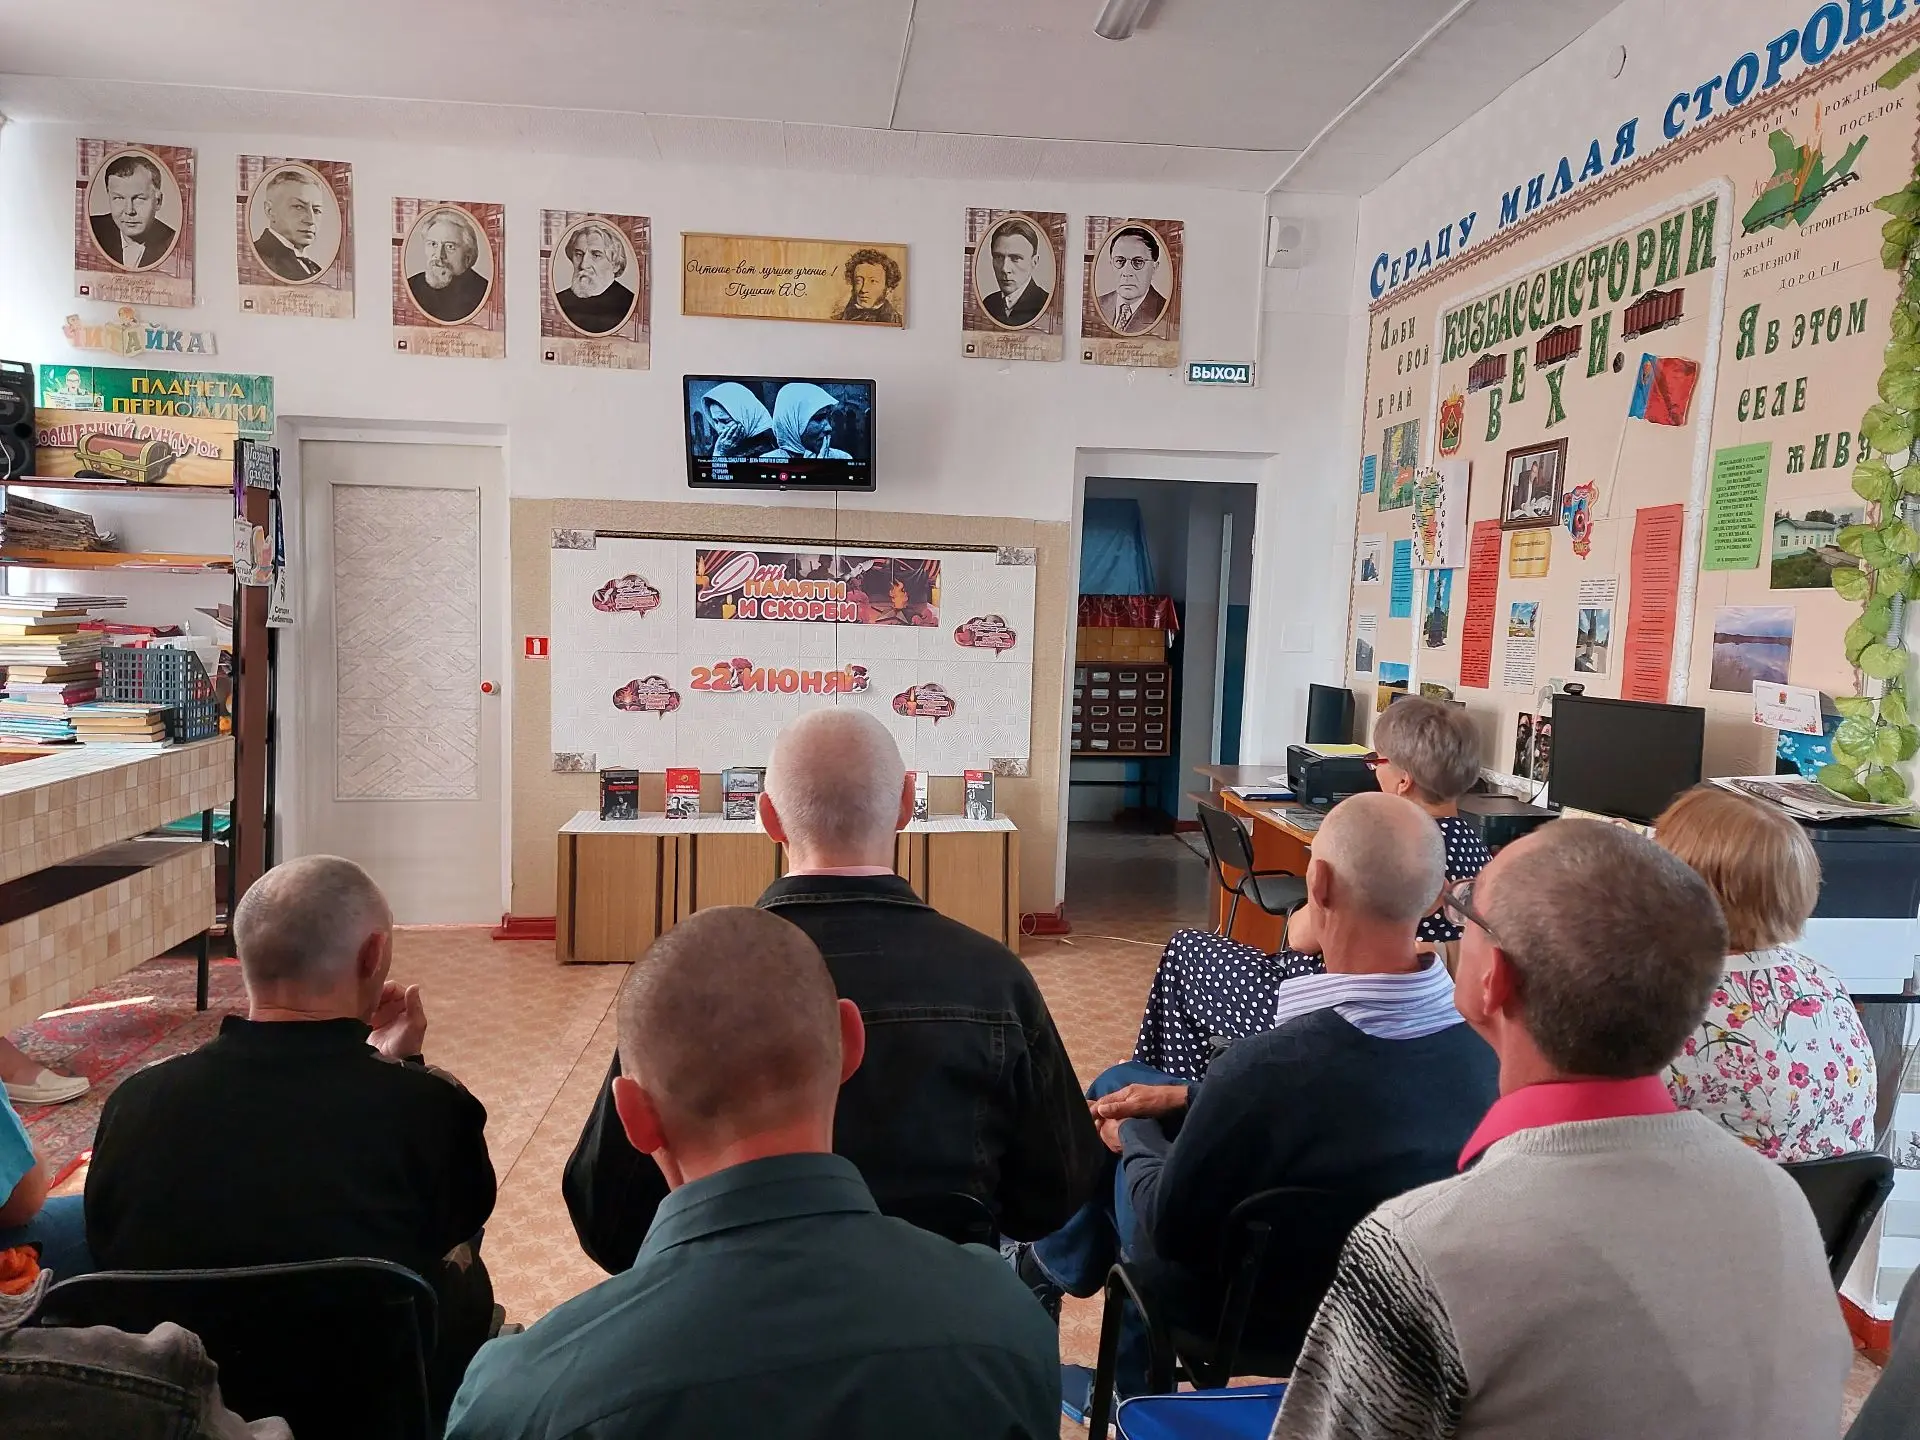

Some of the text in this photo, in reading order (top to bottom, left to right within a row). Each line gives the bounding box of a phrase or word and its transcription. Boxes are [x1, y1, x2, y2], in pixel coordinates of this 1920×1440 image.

[1498, 117, 1639, 229] МИЛАЯ
[1663, 0, 1920, 139] СТОРОН
[1739, 107, 1799, 144] СВОИМ
[1839, 97, 1904, 136] ПОСЕЛОК
[1732, 236, 1775, 262] ОБЯЗАН
[1742, 248, 1801, 279] ЖЕЛЕЗНОЙ
[759, 266, 794, 279] лучшее
[796, 267, 827, 279] учение
[1776, 260, 1840, 291] ДОРОГИ
[725, 282, 808, 299] Пушкин А.С.
[1736, 298, 1868, 361] Я В ЭТОМ
[131, 377, 246, 399] ПЛАНЕТА
[1192, 366, 1247, 381] ВЫХОД
[112, 397, 267, 424] ПЕРИОДИКИ
[1737, 376, 1809, 423] СЕЛЕ
[698, 552, 788, 601] День
[743, 578, 847, 601] ПАМЯТИ
[738, 599, 858, 622] И СКОРБИ
[690, 666, 851, 695] 22 ИЮНЯ
